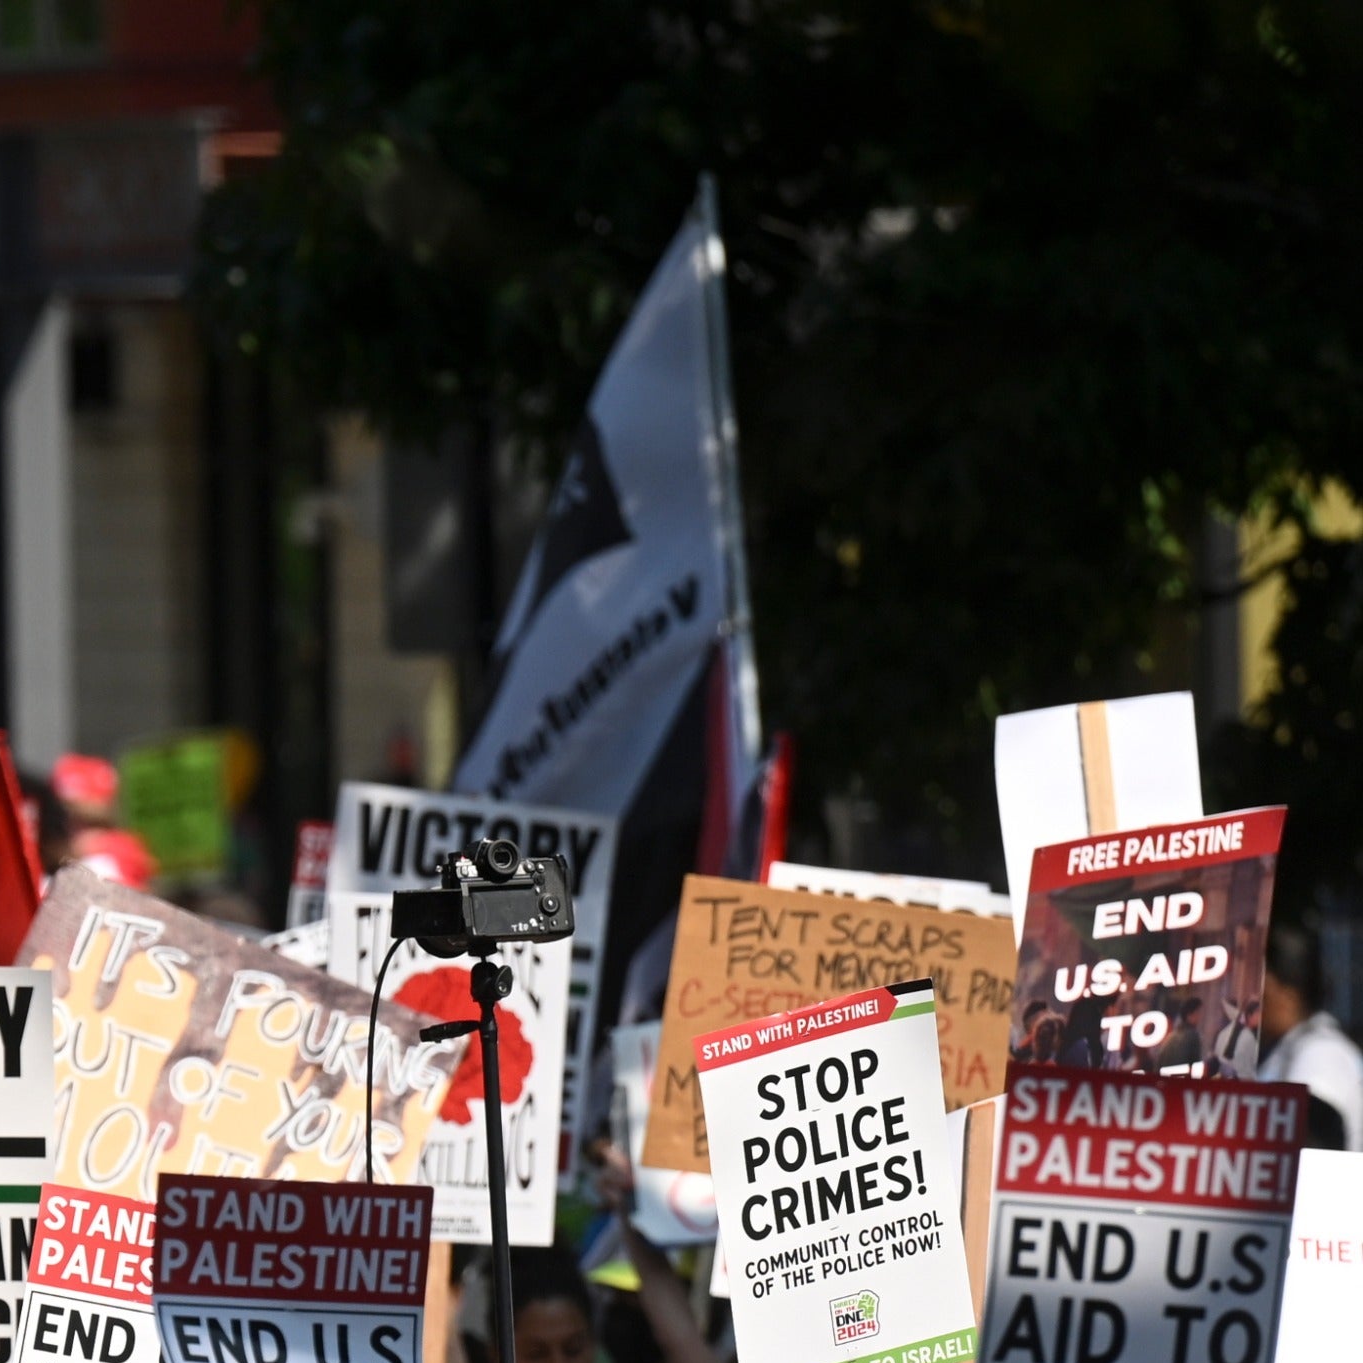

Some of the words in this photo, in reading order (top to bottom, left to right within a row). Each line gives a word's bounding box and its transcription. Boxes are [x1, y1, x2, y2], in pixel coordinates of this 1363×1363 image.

[1068, 835, 1121, 876] FREE
[1123, 821, 1244, 867] PALESTINE
[693, 895, 821, 946] TENT
[827, 910, 967, 960] SCRAPS
[1091, 890, 1204, 941] END
[726, 944, 805, 985] FOR
[1053, 961, 1129, 1002] U.S.
[1133, 945, 1228, 988] AID
[702, 1031, 753, 1061] STAND
[756, 1019, 794, 1047] WITH
[796, 998, 879, 1037] PALESTINE!
[1101, 1011, 1170, 1051] TO
[53, 1002, 170, 1097] OUT
[169, 1057, 260, 1121] OF
[264, 1081, 404, 1183] YOUR
[756, 1048, 879, 1121] STOP
[1007, 1074, 1166, 1132] STAND
[1183, 1088, 1298, 1144] WITH
[742, 1096, 910, 1184] POLICE
[1004, 1132, 1292, 1201] PALESTINE!
[162, 1187, 305, 1234] STAND
[322, 1193, 424, 1241] WITH
[741, 1149, 928, 1242] CRIMES!
[159, 1240, 421, 1295] PALESTINE!
[745, 1234, 851, 1280] COMMUNITY
[858, 1210, 944, 1246] CONTROL
[752, 1279, 776, 1300] OF
[782, 1267, 815, 1290] THE
[822, 1251, 885, 1280] POLICE
[892, 1232, 942, 1262] NOW!
[1006, 1216, 1137, 1284] END
[1164, 1229, 1268, 1296] U.S
[1297, 1237, 1352, 1263] THE
[835, 1309, 865, 1327] DNC
[837, 1320, 876, 1341] 2024
